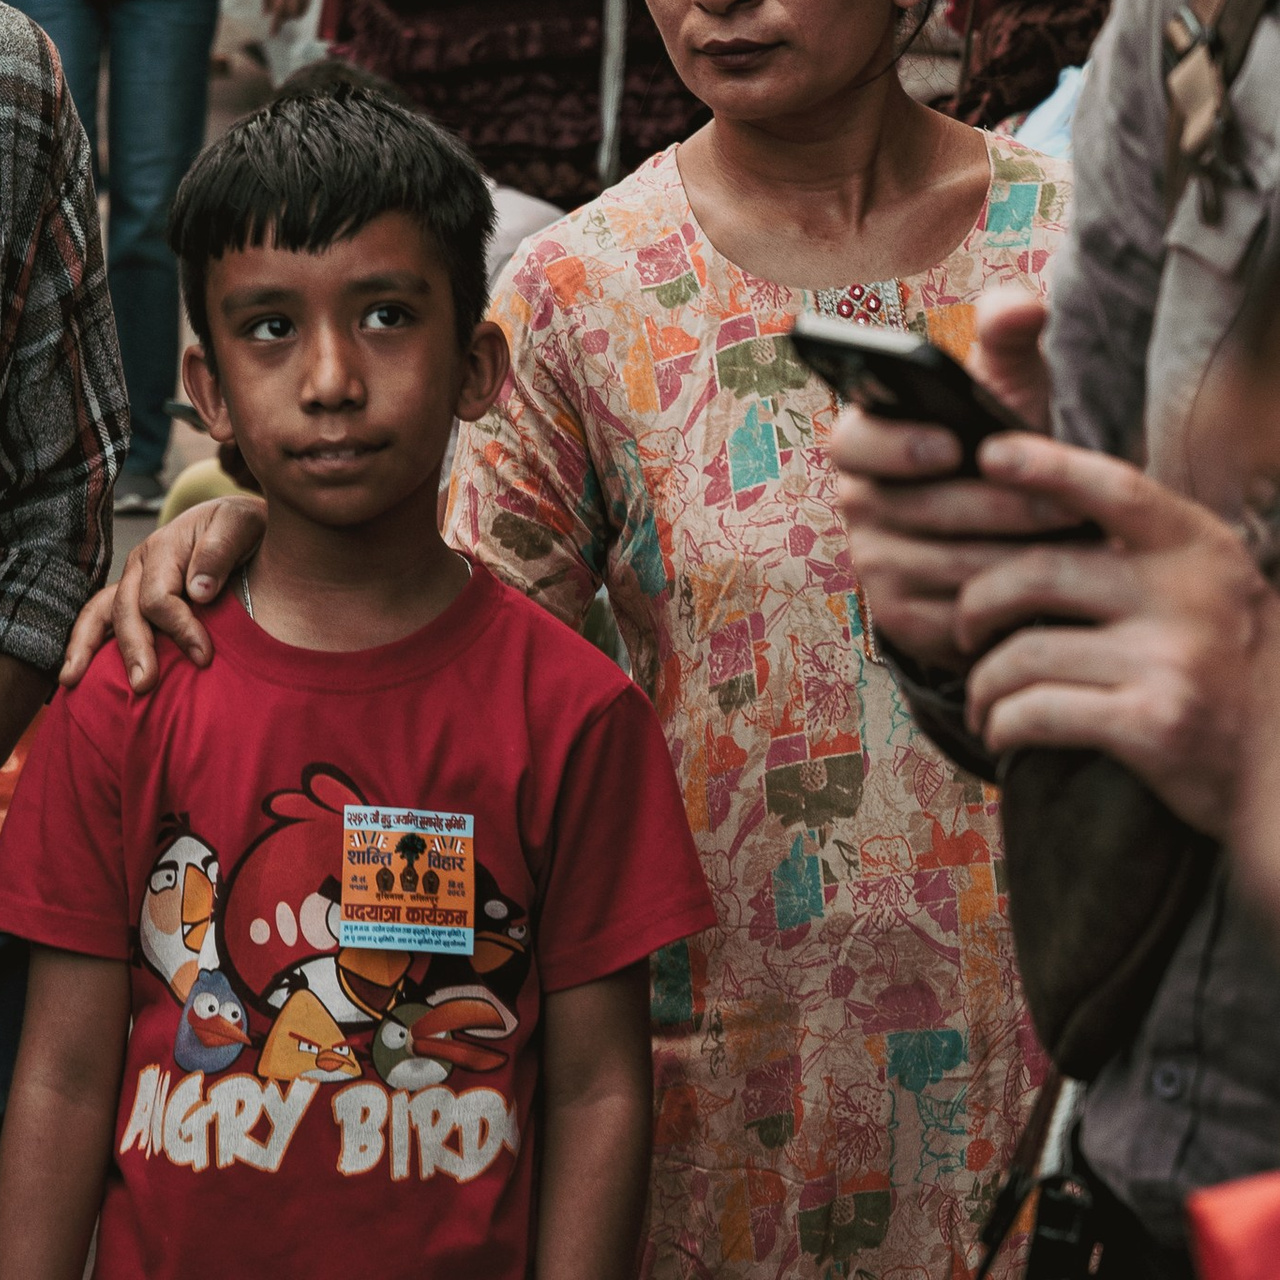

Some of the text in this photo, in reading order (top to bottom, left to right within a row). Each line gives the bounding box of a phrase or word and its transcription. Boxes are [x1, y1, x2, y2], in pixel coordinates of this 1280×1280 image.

[347, 846, 467, 872] शान्ति विहार
[344, 902, 468, 926] पदयात्रा कार्यक्रम
[120, 1063, 319, 1174] ANGRY
